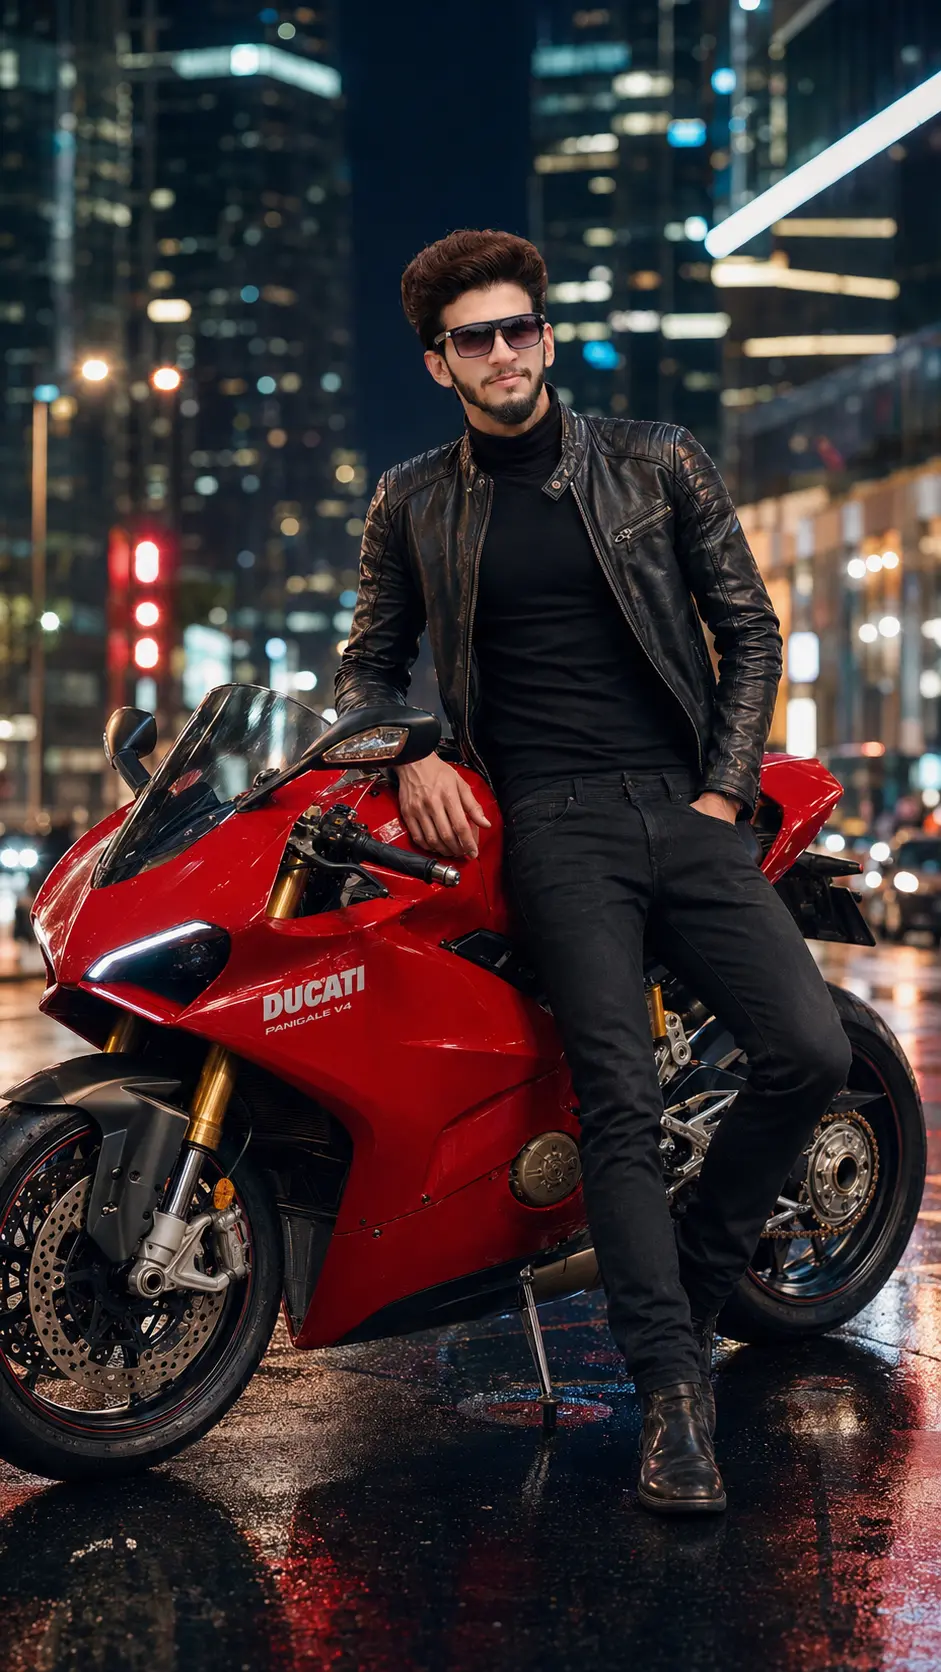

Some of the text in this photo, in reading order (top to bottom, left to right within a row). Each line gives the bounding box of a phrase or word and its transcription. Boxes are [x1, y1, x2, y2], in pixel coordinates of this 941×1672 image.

[263, 965, 365, 1022] DUCATI
[265, 1001, 352, 1035] PANIGALE V4
